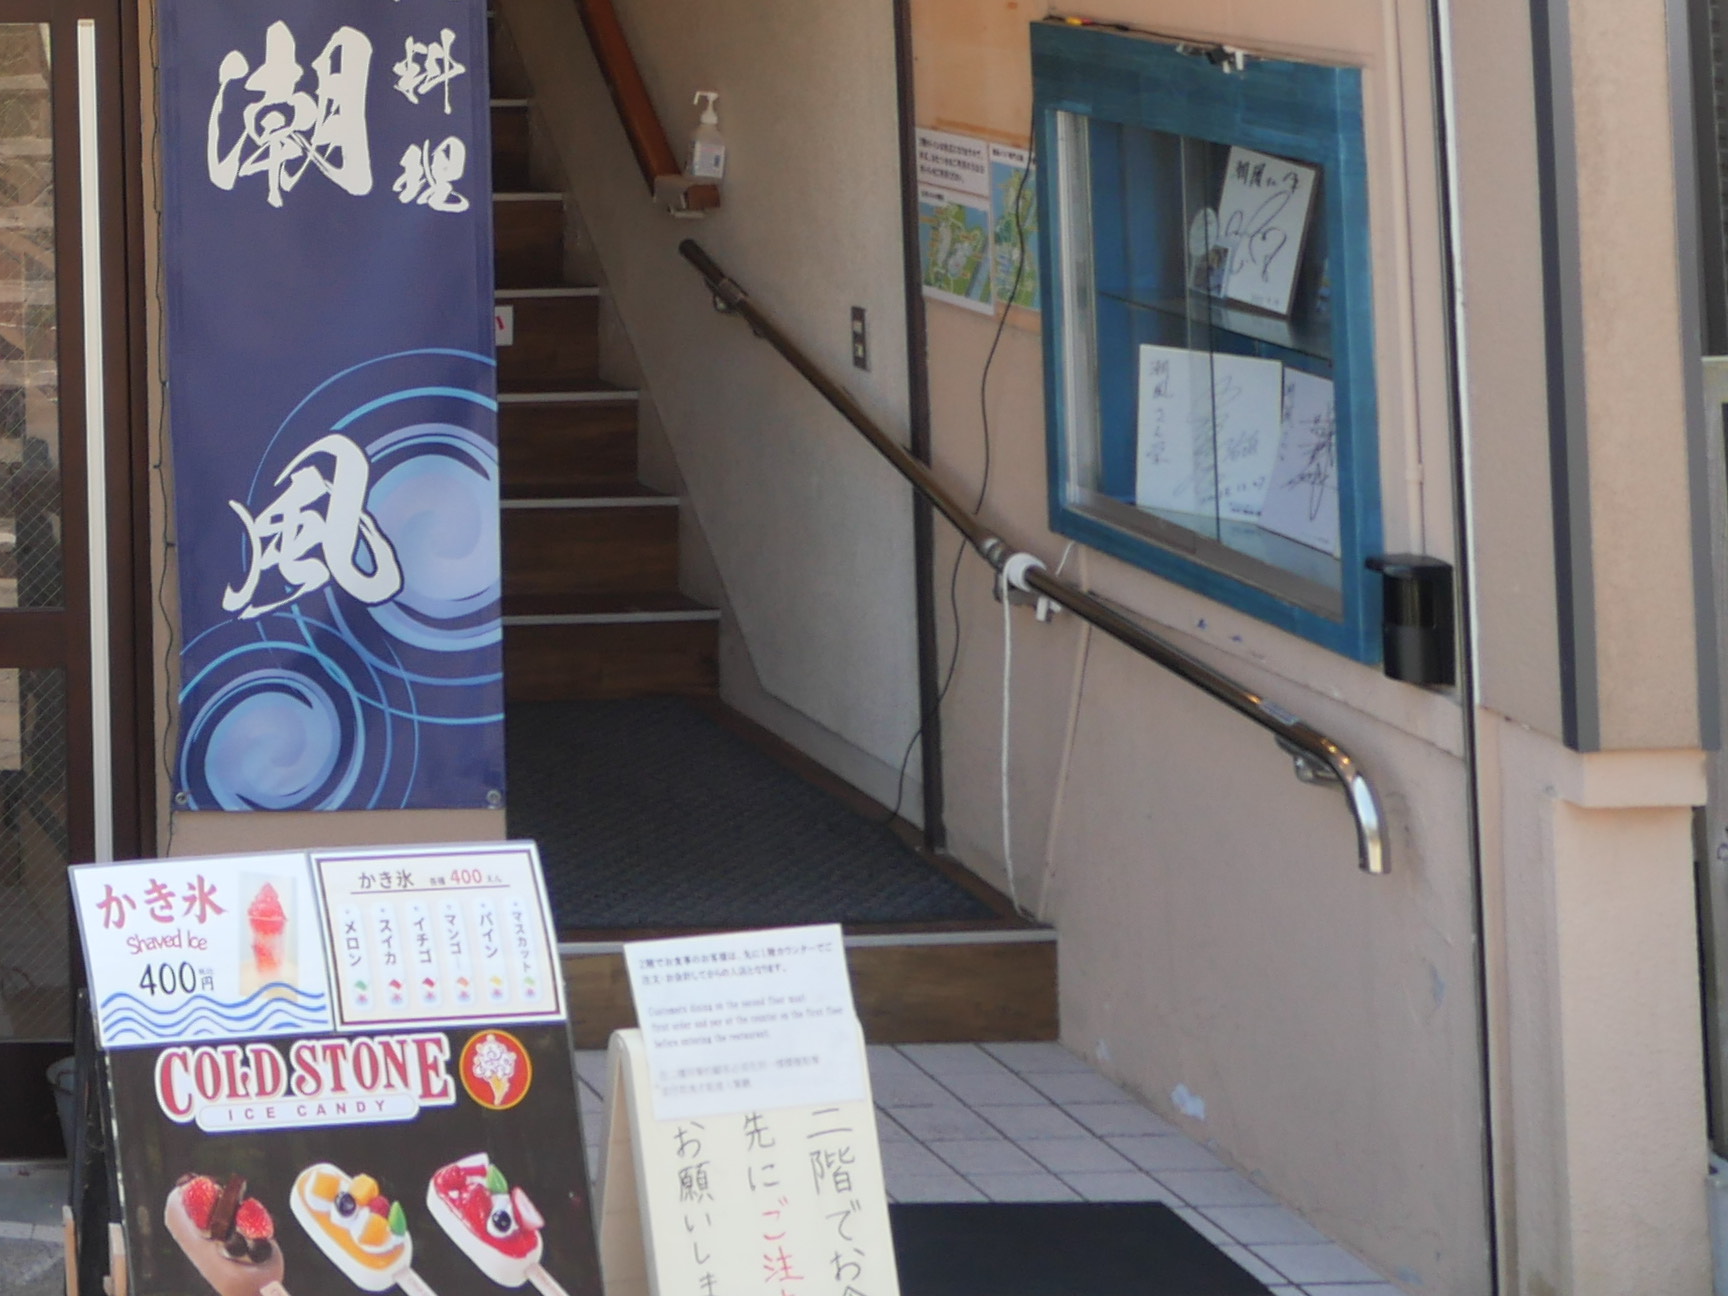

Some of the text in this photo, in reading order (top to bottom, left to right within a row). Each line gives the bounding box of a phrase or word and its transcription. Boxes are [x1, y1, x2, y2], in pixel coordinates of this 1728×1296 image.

[207, 20, 402, 620] 潮風
[96, 874, 229, 929] かき氷
[358, 869, 414, 890] かき氷
[450, 869, 483, 885] 400
[126, 929, 208, 955] Shaved Ice
[344, 920, 362, 967] メロン
[379, 918, 397, 966] スイカ
[413, 917, 432, 964] イチゴ
[512, 911, 533, 973] マスカット
[159, 1037, 453, 1117] COLD STONE
[229, 1100, 386, 1121] ICE CANDY
[744, 1112, 804, 1296] 先にご注
[806, 1108, 870, 1296] 二階でお
